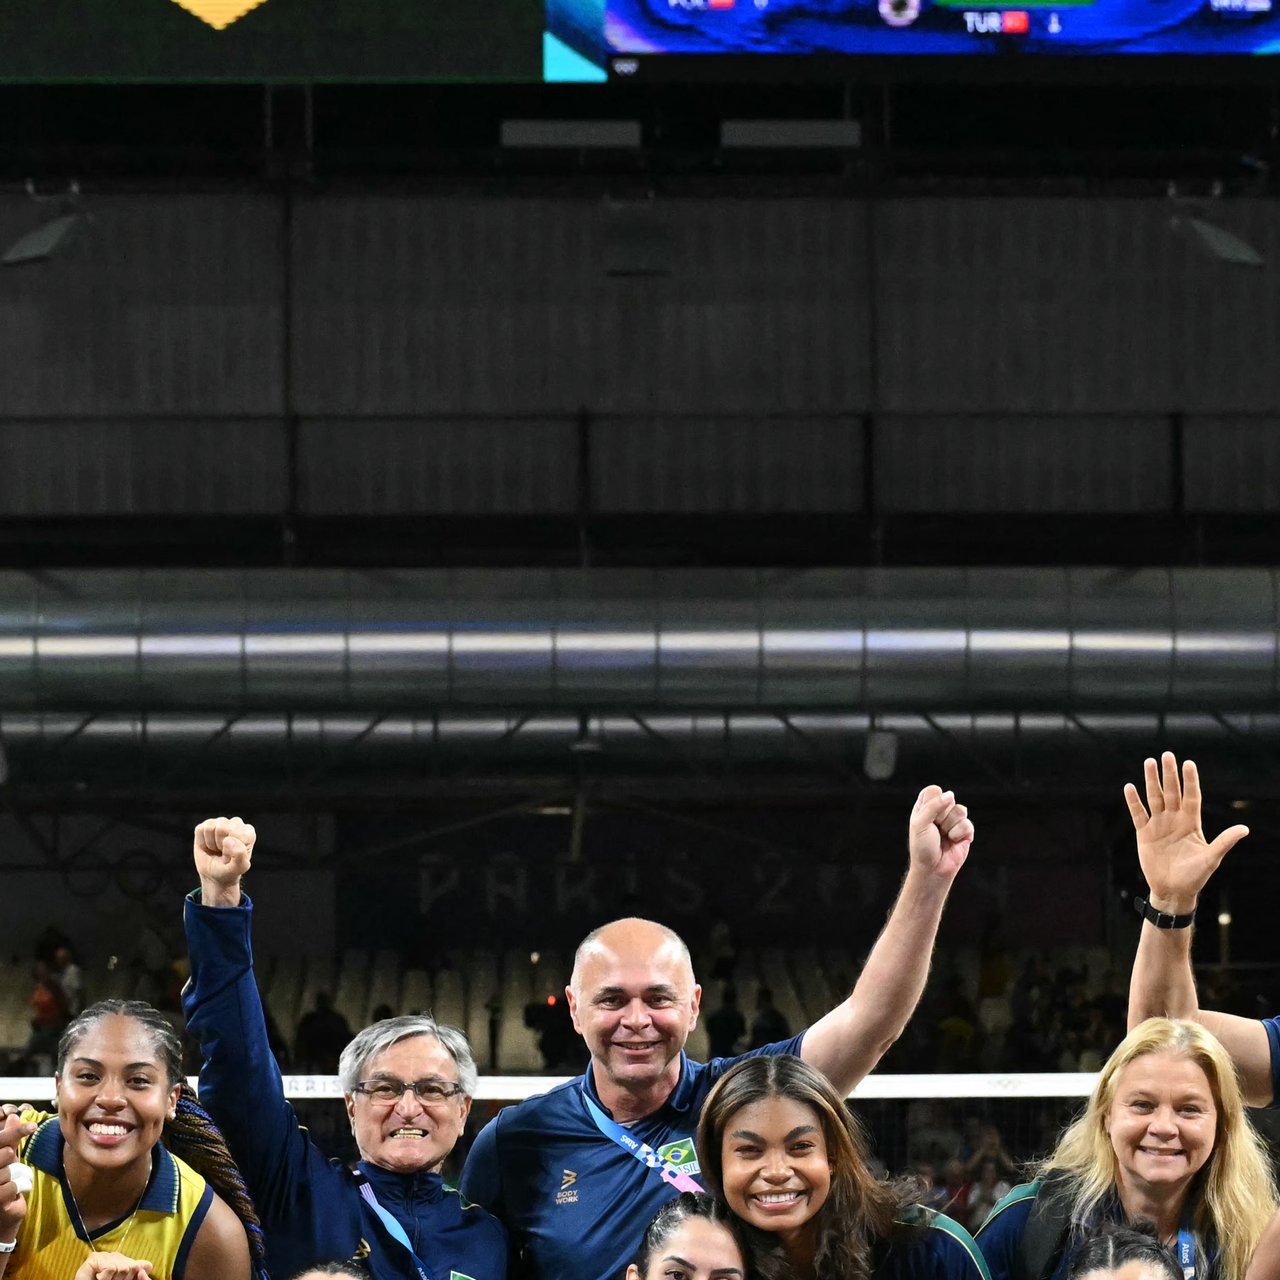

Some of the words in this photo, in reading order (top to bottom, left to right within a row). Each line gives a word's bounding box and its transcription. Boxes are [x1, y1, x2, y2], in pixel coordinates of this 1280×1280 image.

[964, 11, 1002, 33] TUR
[621, 1134, 639, 1150] Atos
[555, 1196, 579, 1205] WORK
[556, 1189, 578, 1199] BODY
[1181, 1242, 1190, 1264] Atos
